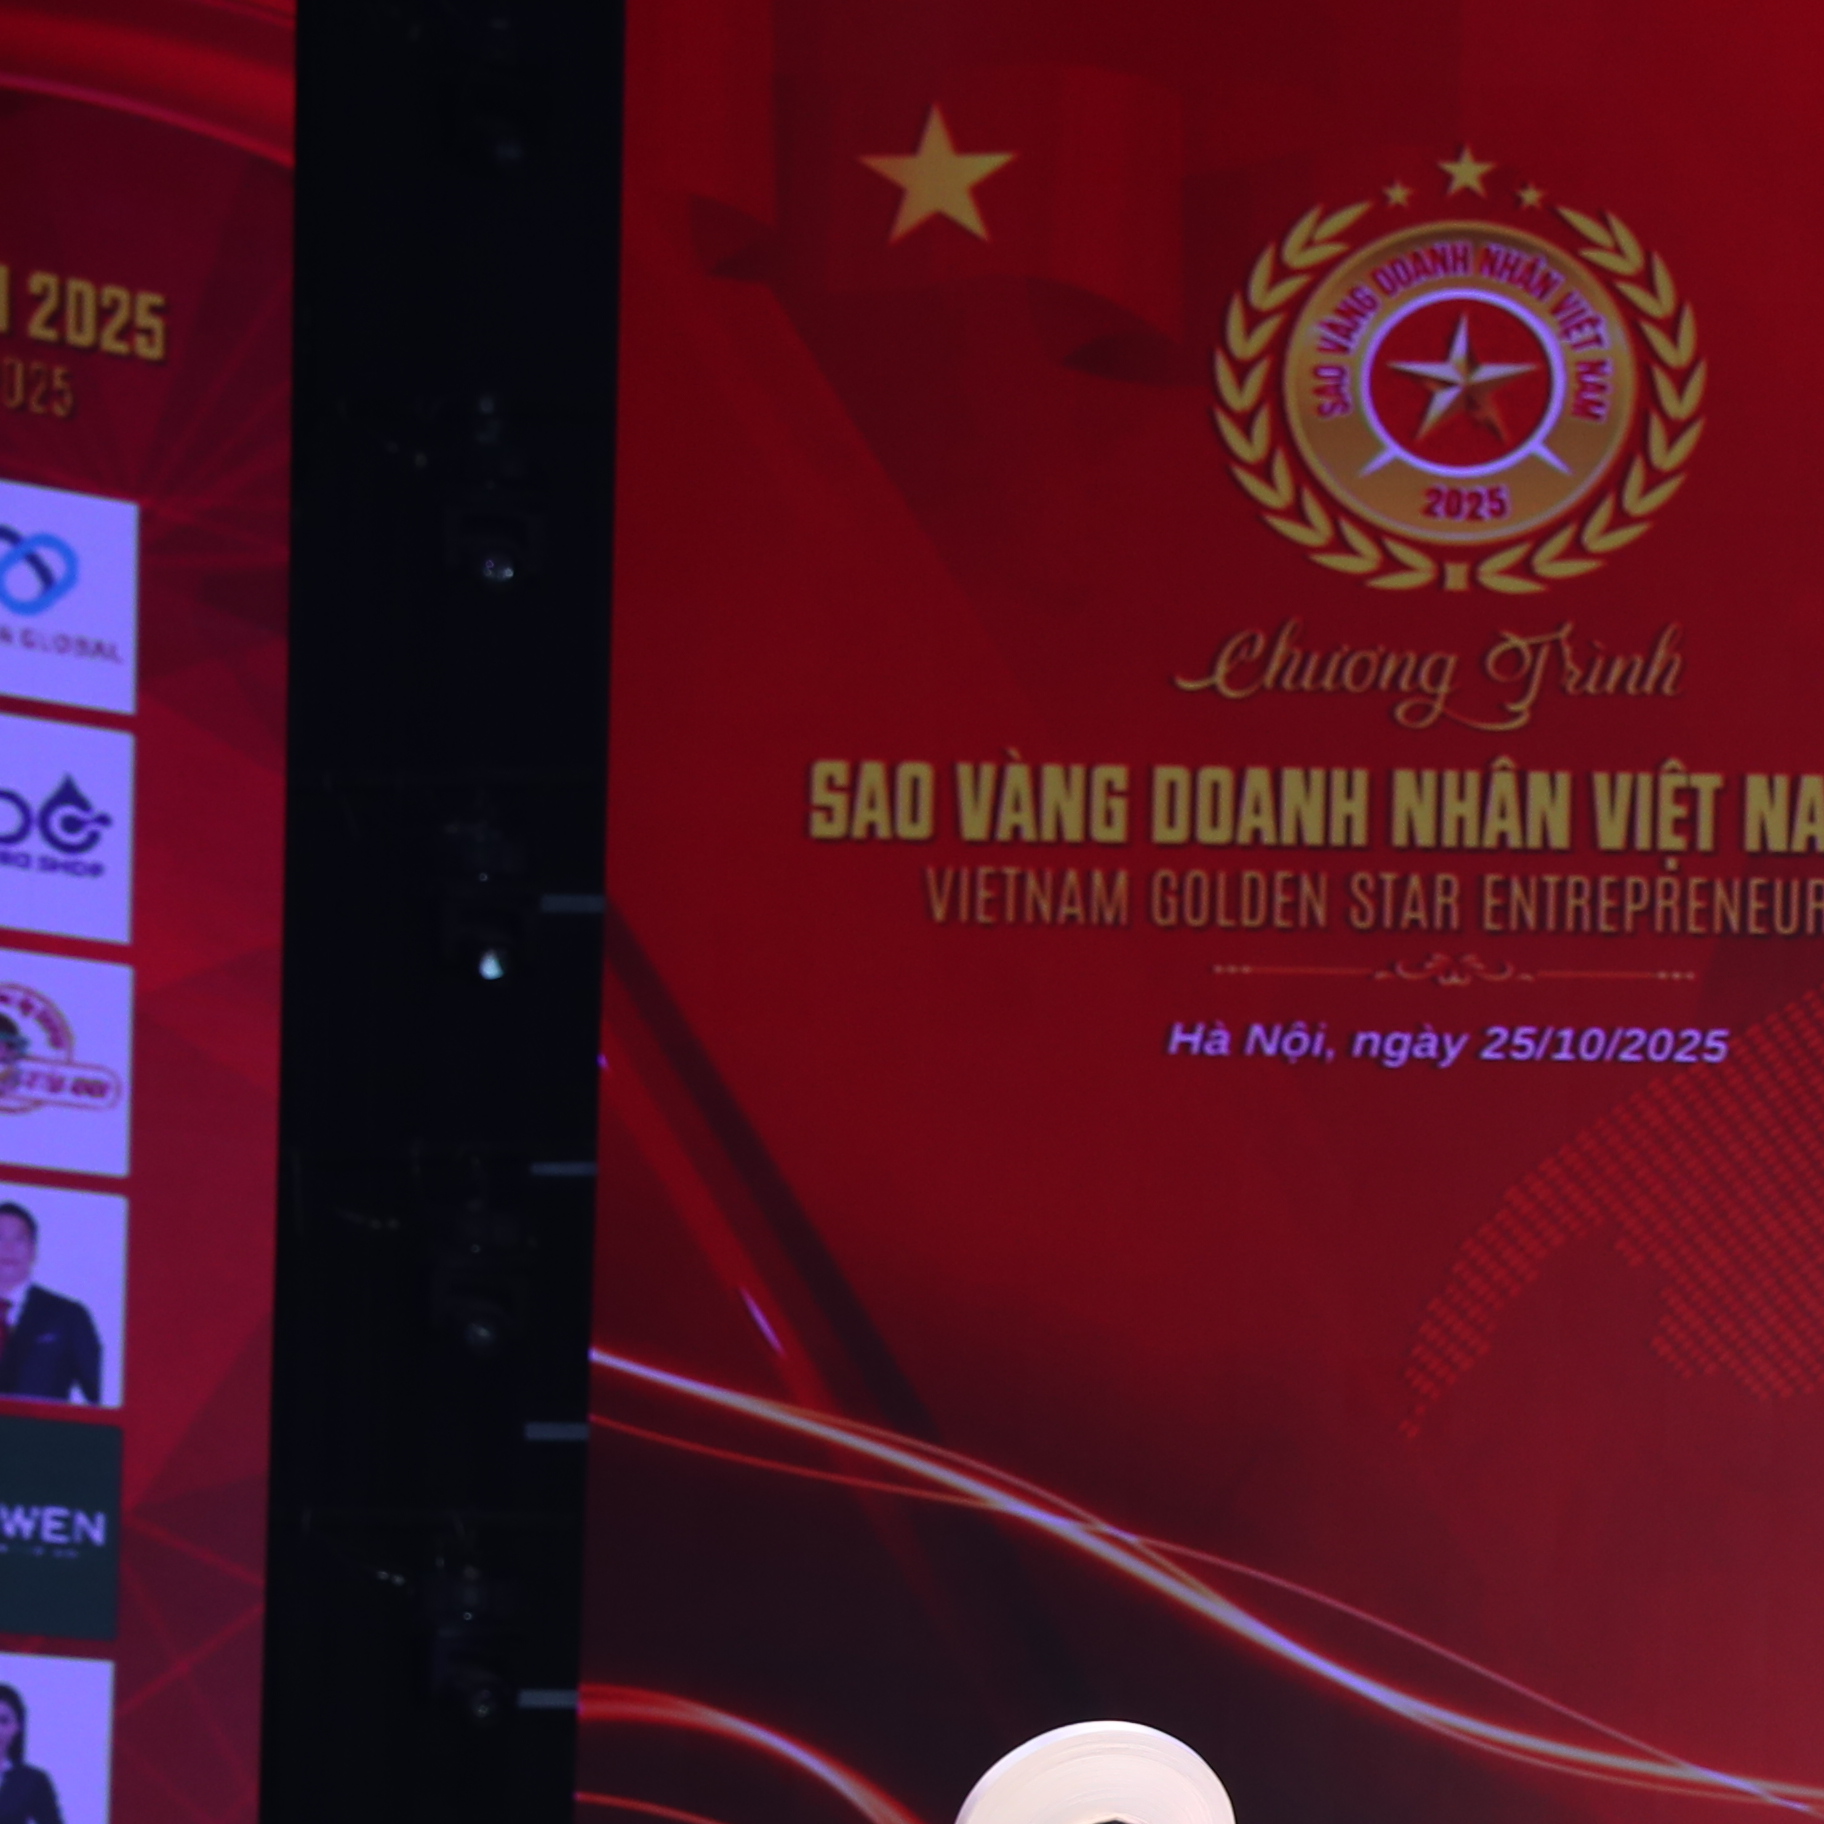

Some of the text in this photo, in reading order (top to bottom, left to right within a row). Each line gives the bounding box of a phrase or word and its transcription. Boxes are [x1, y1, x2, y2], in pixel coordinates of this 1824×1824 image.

[28, 270, 166, 361] 2025
[1313, 363, 1351, 419] SAO
[1370, 241, 1473, 297] DOANH
[1572, 358, 1613, 422] NAM
[1422, 483, 1510, 520] 2025
[1175, 619, 1684, 730] Chương Trình
[809, 759, 934, 840] SAO
[955, 749, 1128, 844] VÀNG
[1151, 764, 1371, 848] DOANH
[1392, 756, 1571, 850] NHÂN
[1592, 758, 1724, 870] VIỆT
[925, 866, 1128, 927] VIETNAM
[1151, 869, 1327, 930] GOLDEN
[1349, 871, 1460, 930] STAR
[1167, 1021, 1731, 1069] Hà Nội, ngày 25/10/2025
